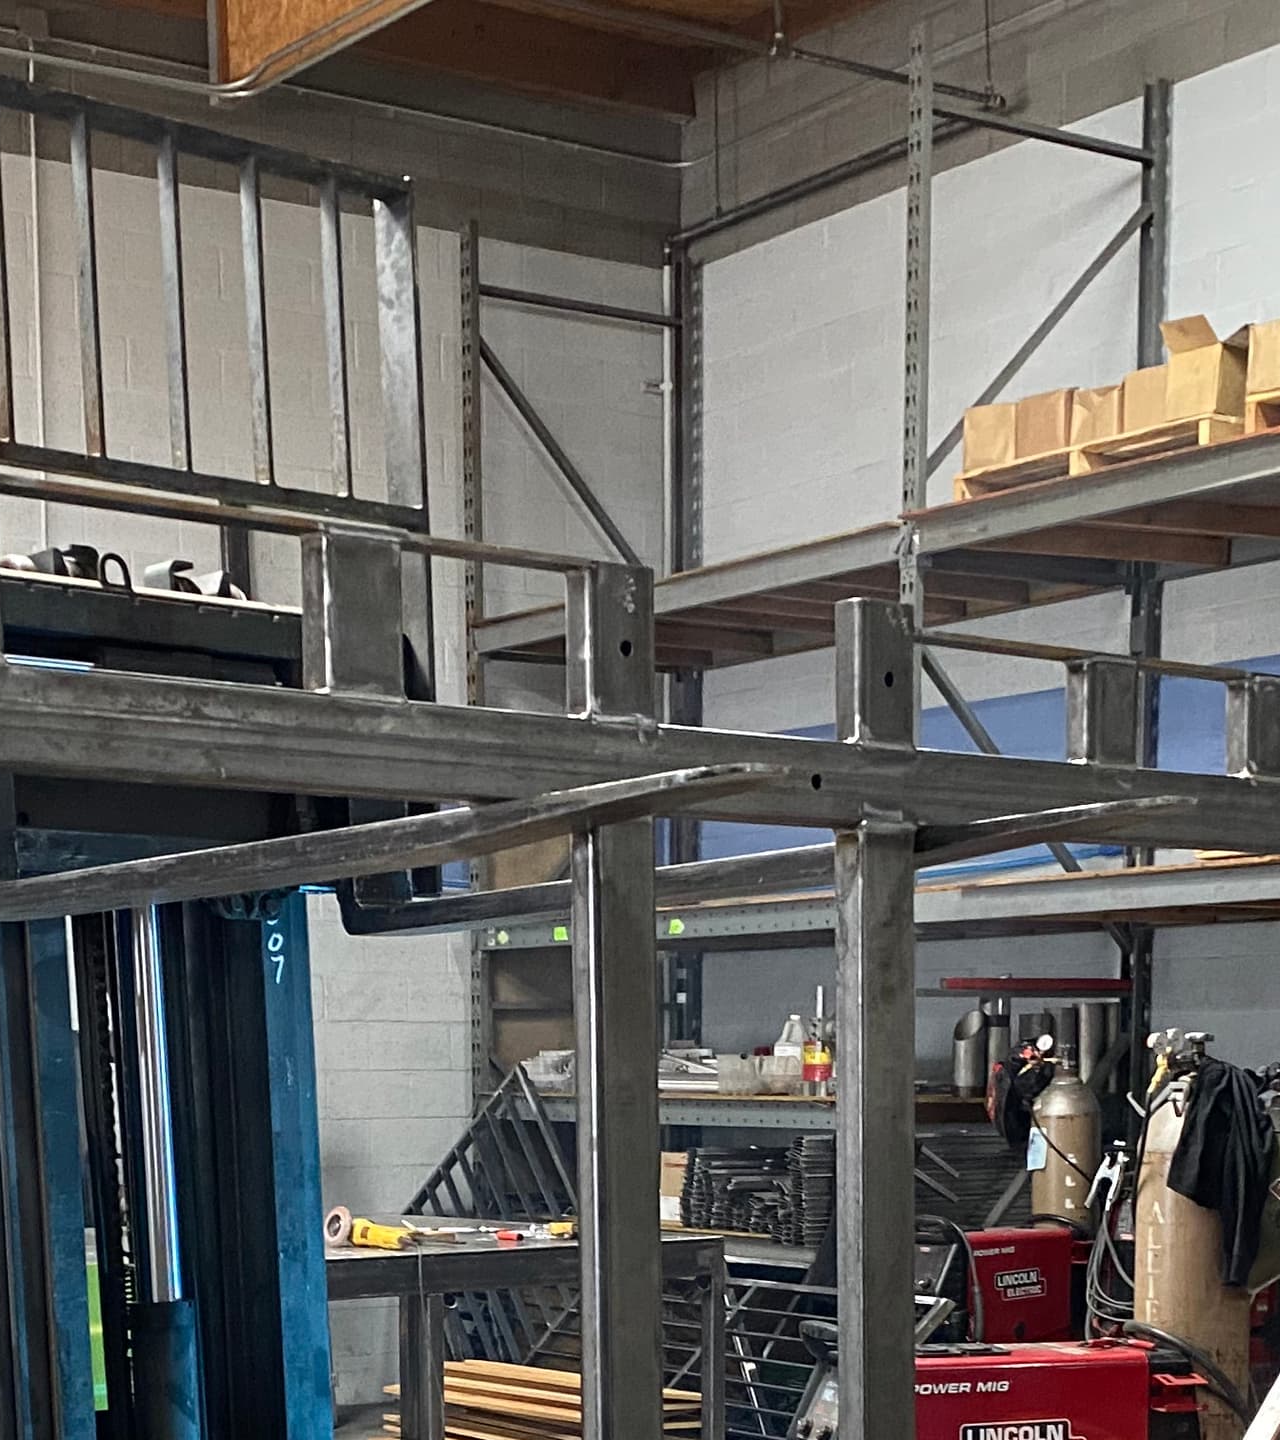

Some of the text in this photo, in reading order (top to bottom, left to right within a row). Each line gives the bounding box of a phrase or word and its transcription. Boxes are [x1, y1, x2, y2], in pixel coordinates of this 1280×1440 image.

[266, 918, 284, 985] 07
[997, 1271, 1038, 1287] LINCOLN
[1006, 1285, 1042, 1298] ELECTRIC
[976, 1380, 1010, 1393] MIG
